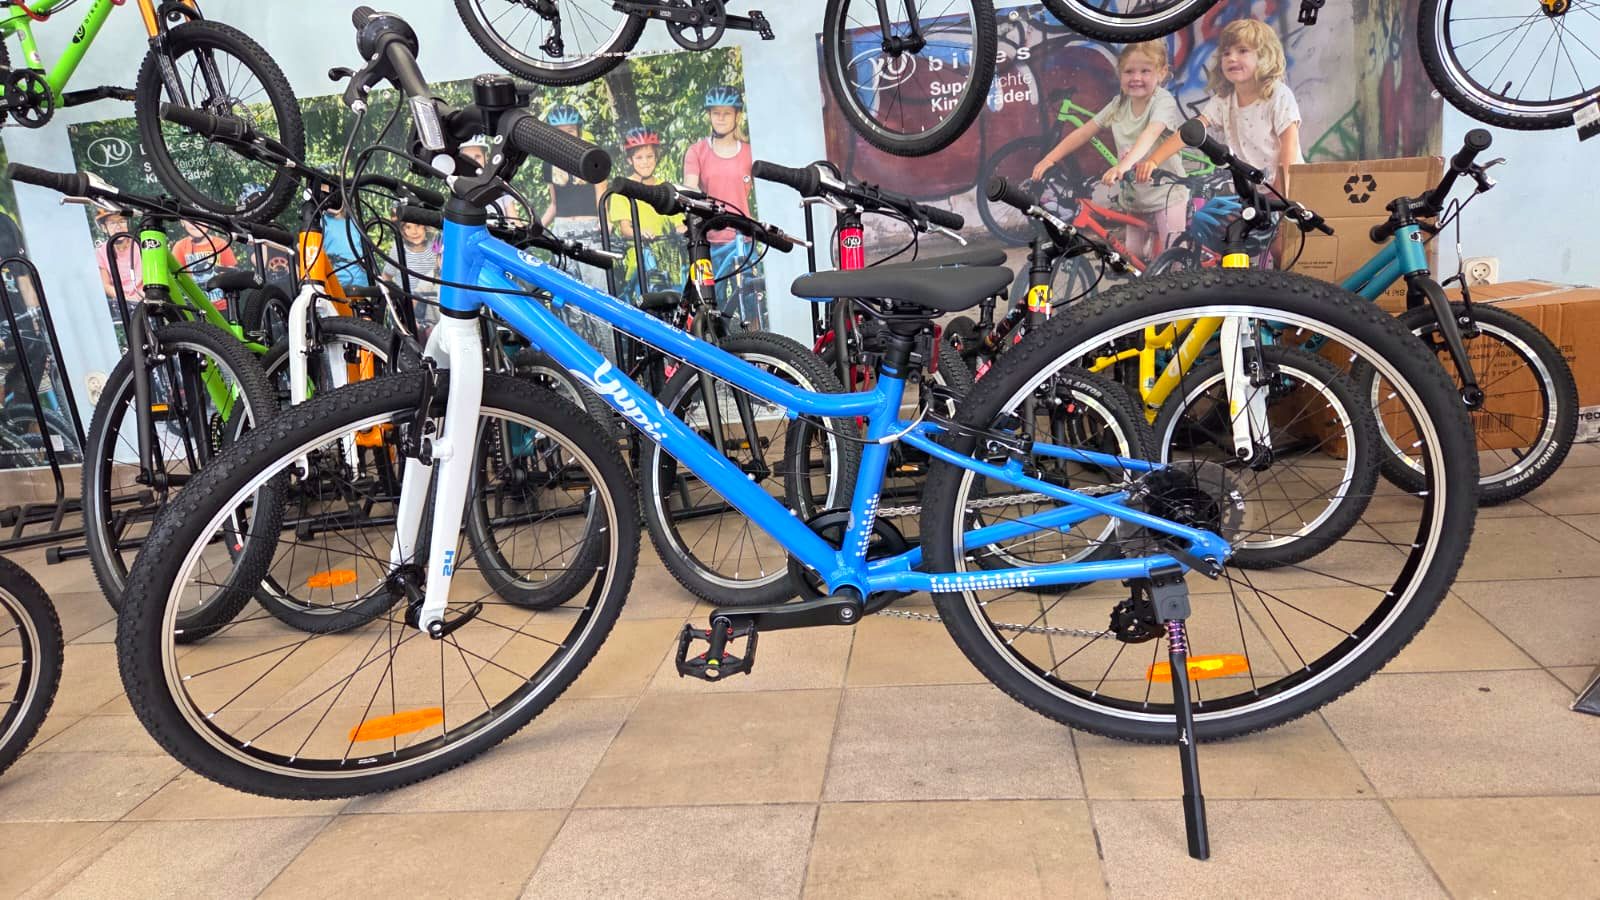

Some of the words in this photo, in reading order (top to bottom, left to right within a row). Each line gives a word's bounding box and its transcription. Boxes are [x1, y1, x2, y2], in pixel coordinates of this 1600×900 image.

[928, 47, 1031, 71] bies
[1535, 441, 1560, 468] KENDA
[1506, 467, 1535, 487] APTOR
